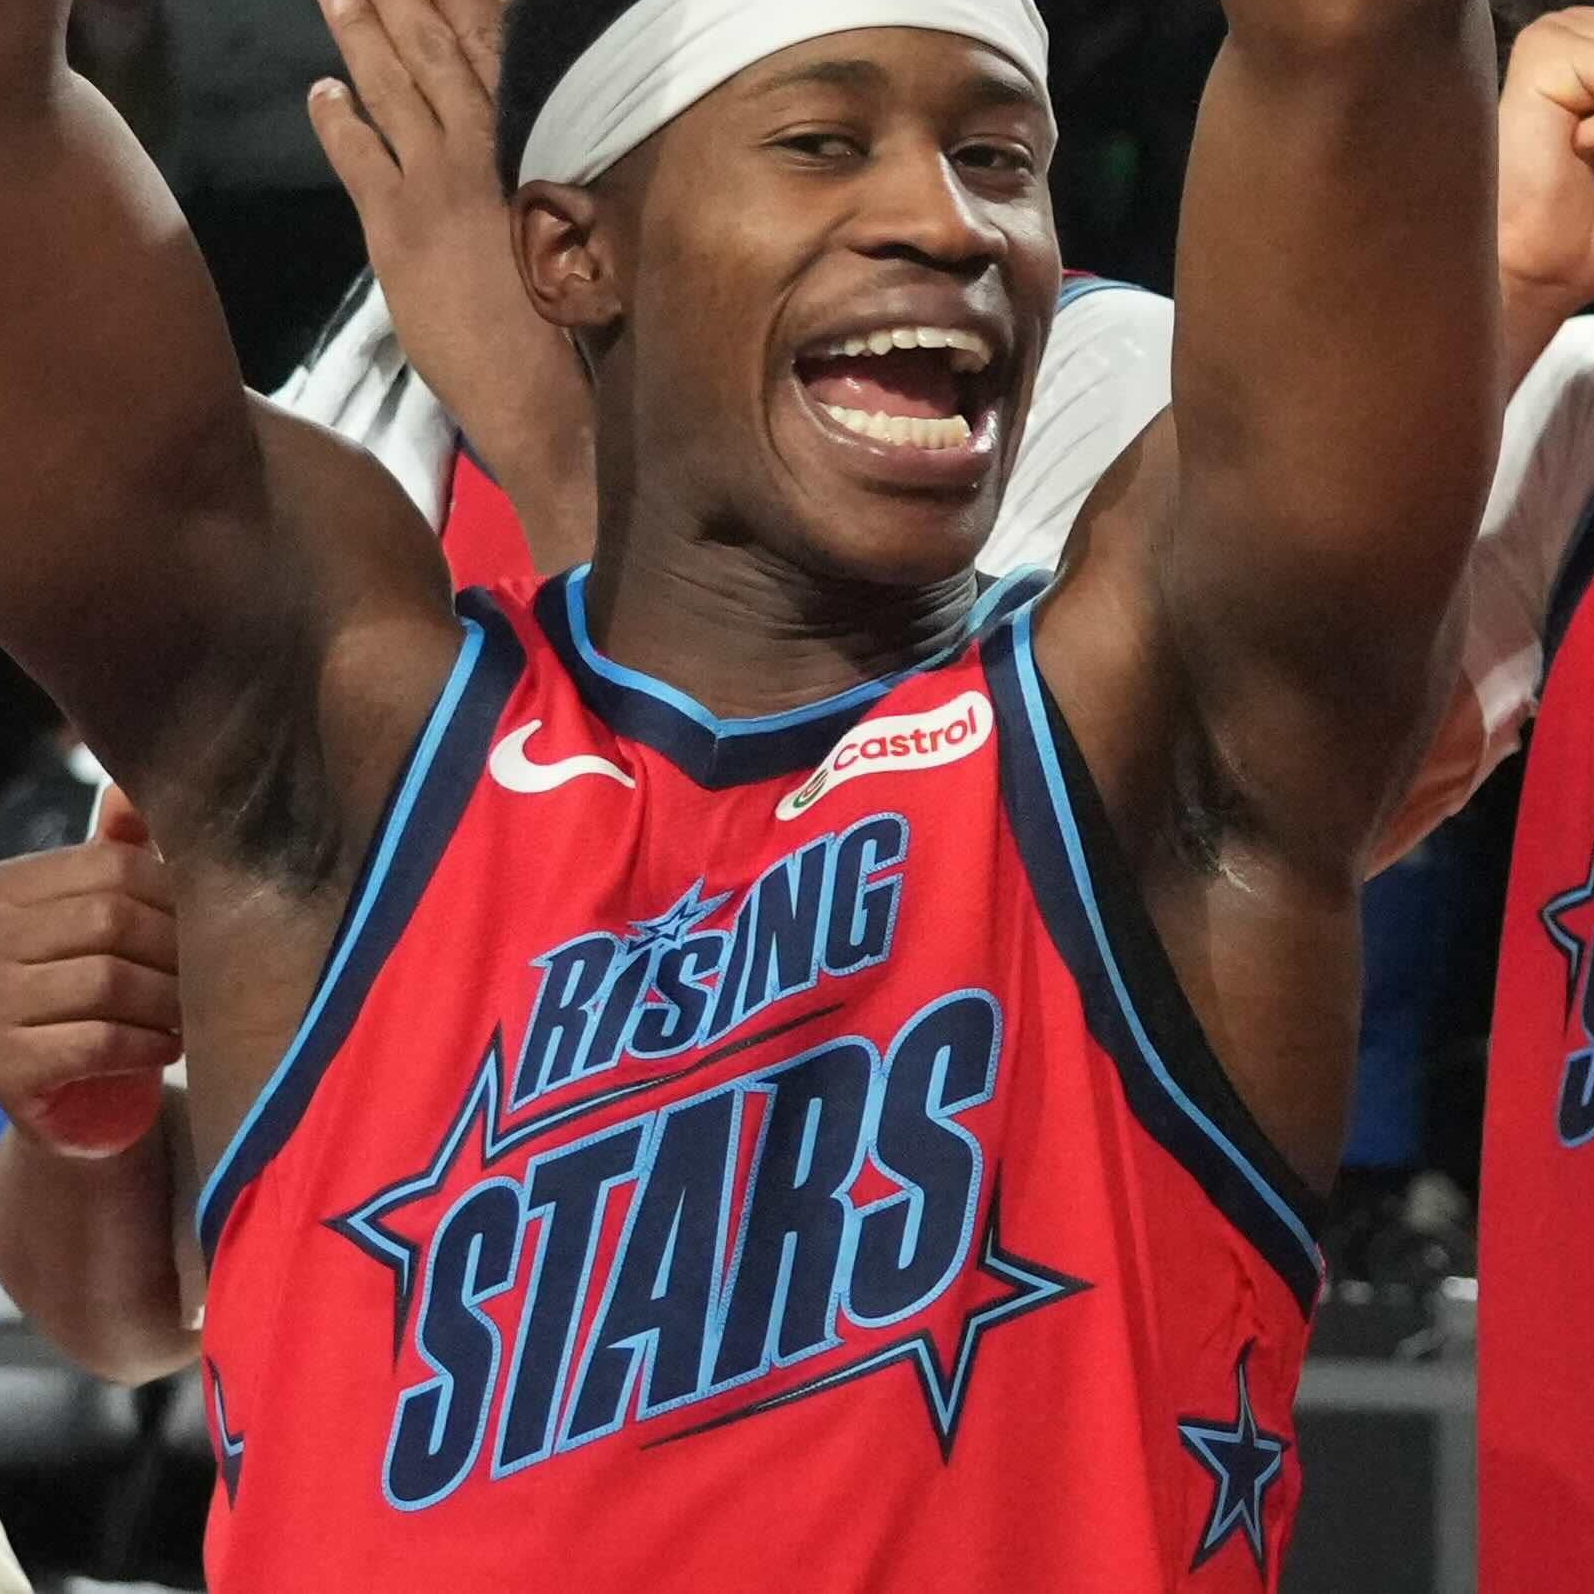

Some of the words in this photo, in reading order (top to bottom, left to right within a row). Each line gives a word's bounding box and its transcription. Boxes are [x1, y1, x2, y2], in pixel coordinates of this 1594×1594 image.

[833, 705, 978, 771] Castrol
[506, 811, 910, 1114] RISING
[382, 987, 1004, 1512] STARS
